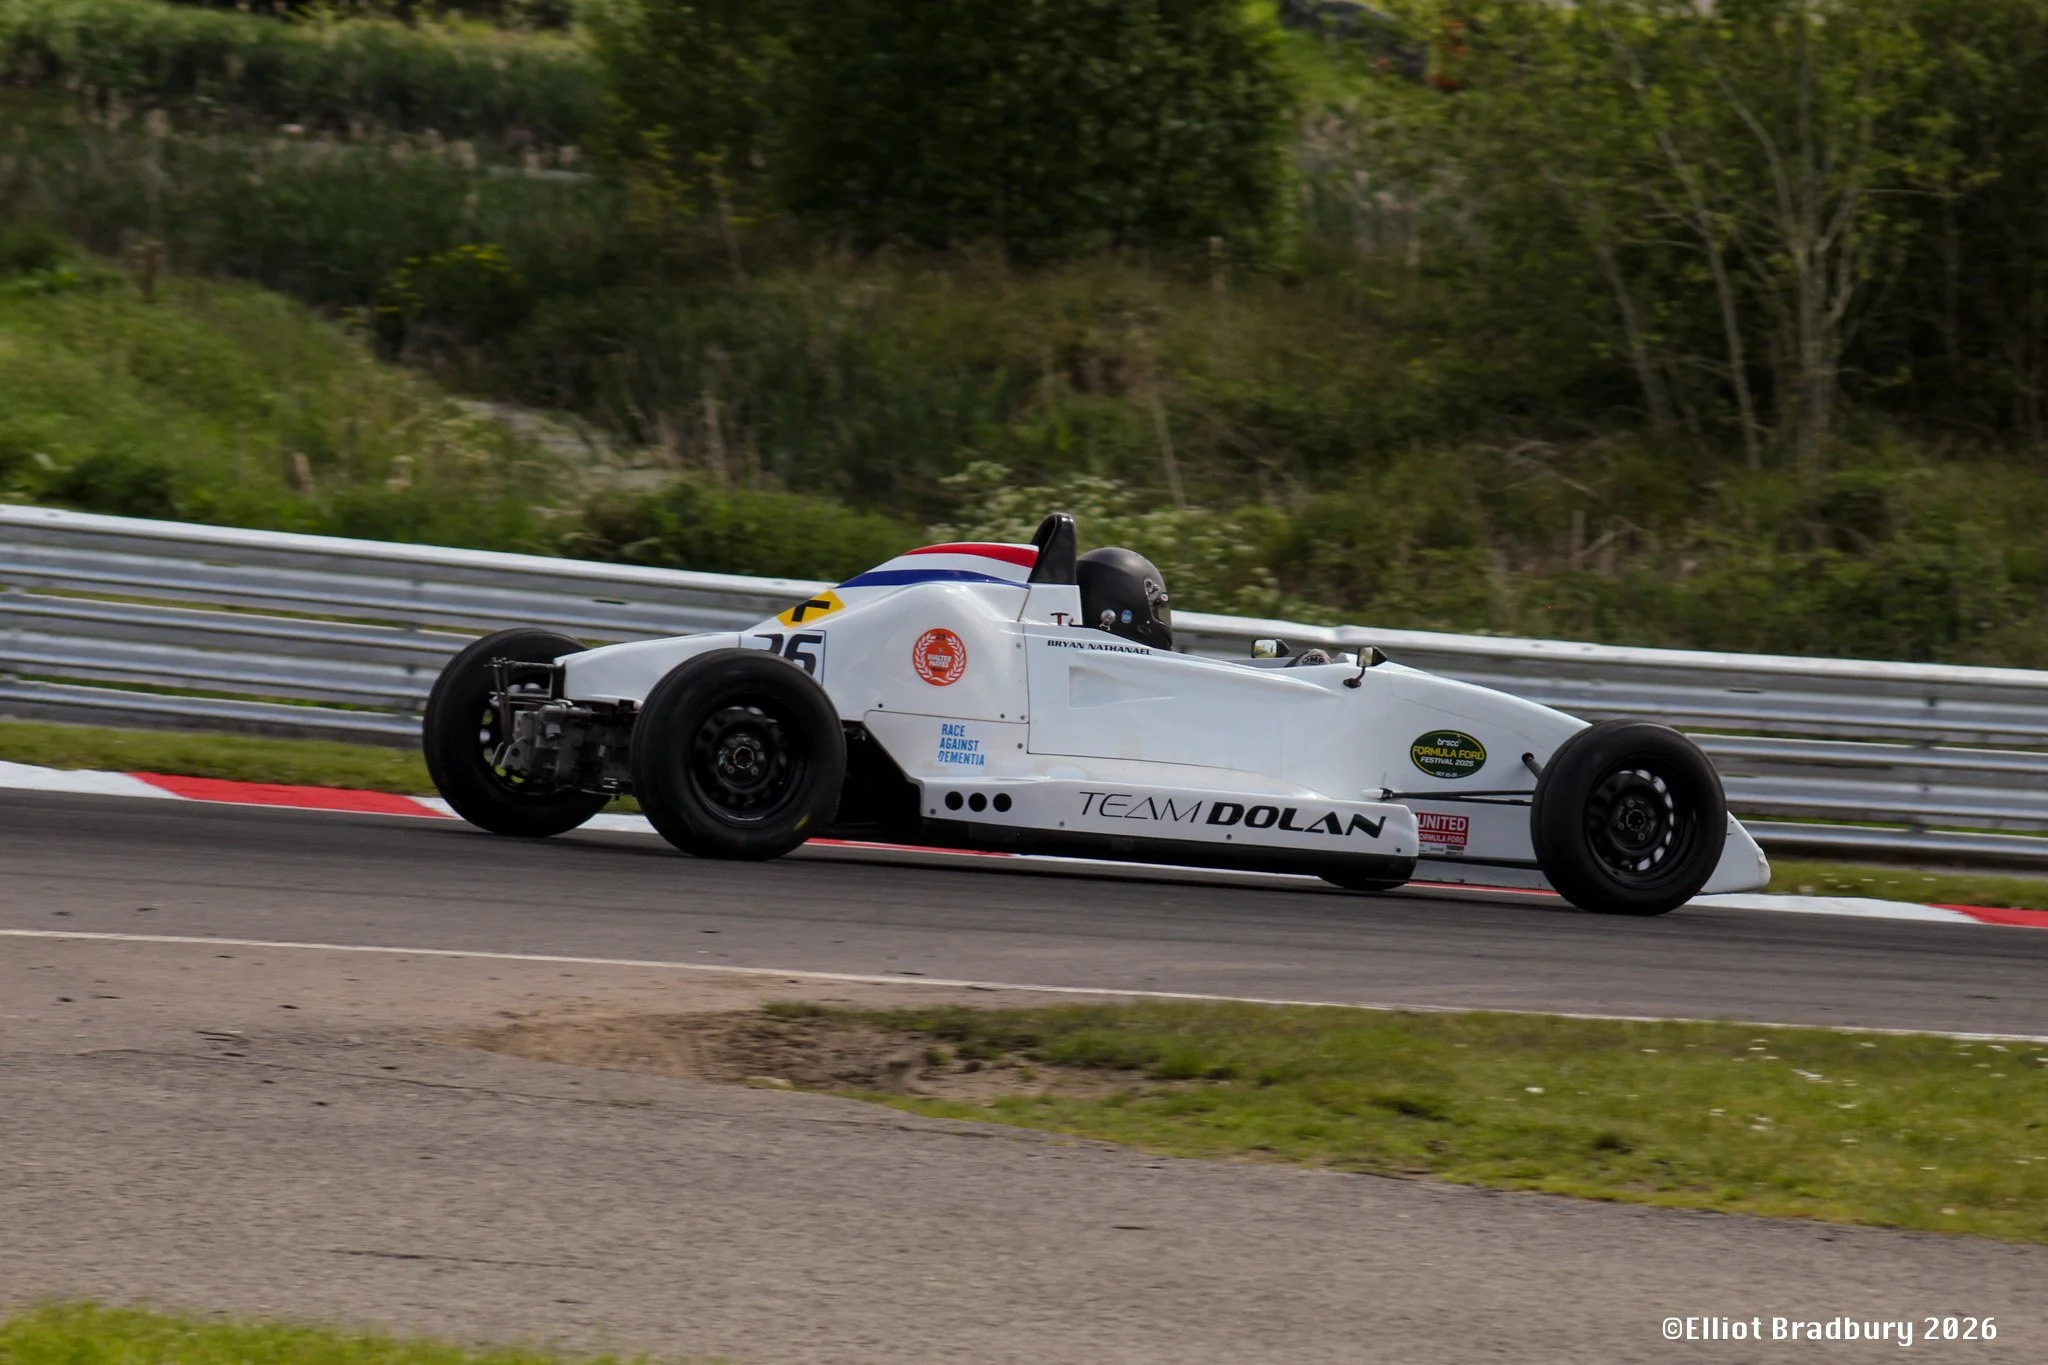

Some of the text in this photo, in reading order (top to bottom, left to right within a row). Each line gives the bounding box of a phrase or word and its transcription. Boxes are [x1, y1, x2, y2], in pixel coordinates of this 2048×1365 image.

[1047, 640, 1152, 655] BRYAN NATHANAEL
[941, 723, 966, 737] RACE
[939, 737, 980, 752] AGAINST
[1437, 738, 1460, 747] brscc
[937, 751, 985, 766] DEMENTIA
[1413, 745, 1484, 760] FORMULA FORD
[1420, 756, 1474, 767] FESTIVAL 2025
[1080, 791, 1387, 839] TEAM DOLAN
[1417, 814, 1467, 832] UNITED
[1418, 833, 1465, 844] ORMULA FORD
